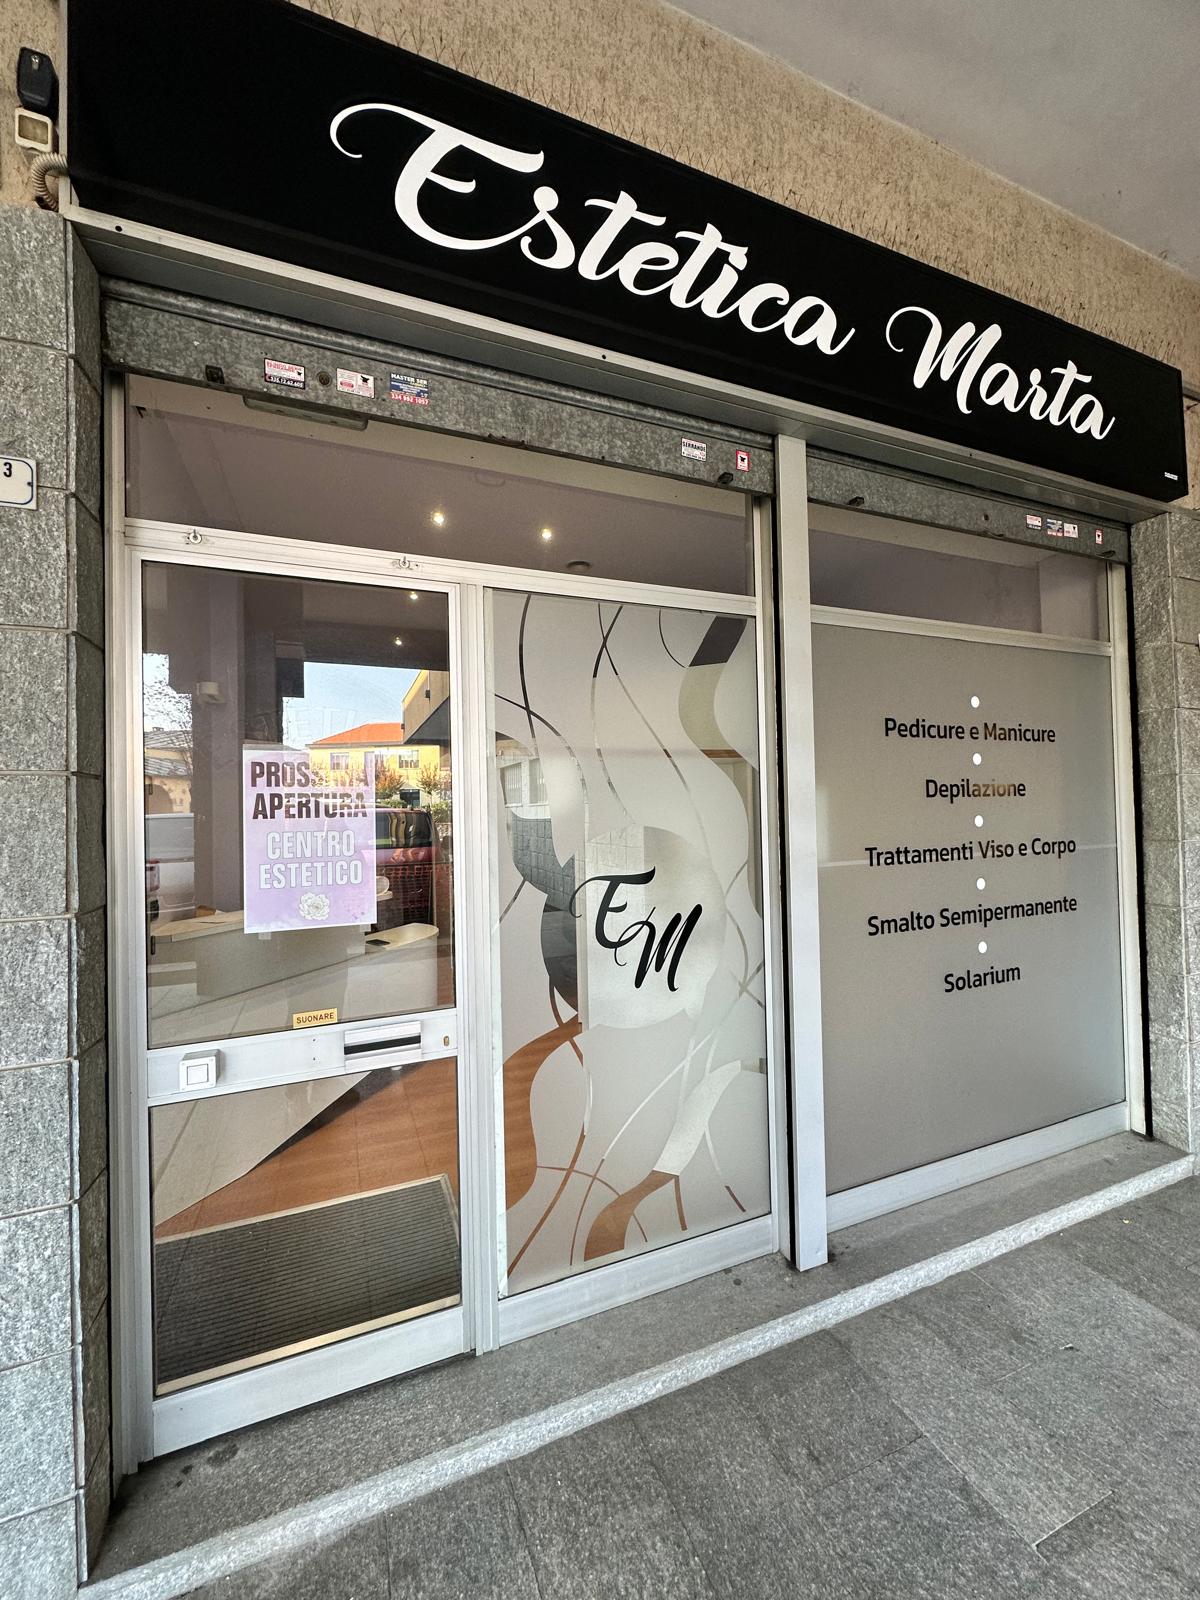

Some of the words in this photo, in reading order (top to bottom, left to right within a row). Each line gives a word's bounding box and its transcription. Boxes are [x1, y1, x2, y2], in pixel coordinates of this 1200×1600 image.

[330, 103, 855, 355] Estetica
[885, 306, 1116, 440] Marta
[3, 462, 12, 478] 3
[884, 717, 965, 740] Pedicure
[969, 727, 979, 740] e
[983, 722, 1056, 743] Manicure
[252, 791, 368, 820] APERTURA
[925, 778, 1026, 804] Depilazione
[266, 829, 355, 860] CENTRO
[865, 840, 974, 867] Trattamenti
[978, 840, 1014, 859] Viso
[1018, 843, 1027, 856] e
[1031, 837, 1076, 860] Corpo
[259, 859, 364, 890] ESTETICO
[867, 910, 935, 937] Smalto
[939, 895, 1077, 928] Semipermanente
[944, 965, 1021, 993] Solarium
[296, 1012, 335, 1024] SUONARE
